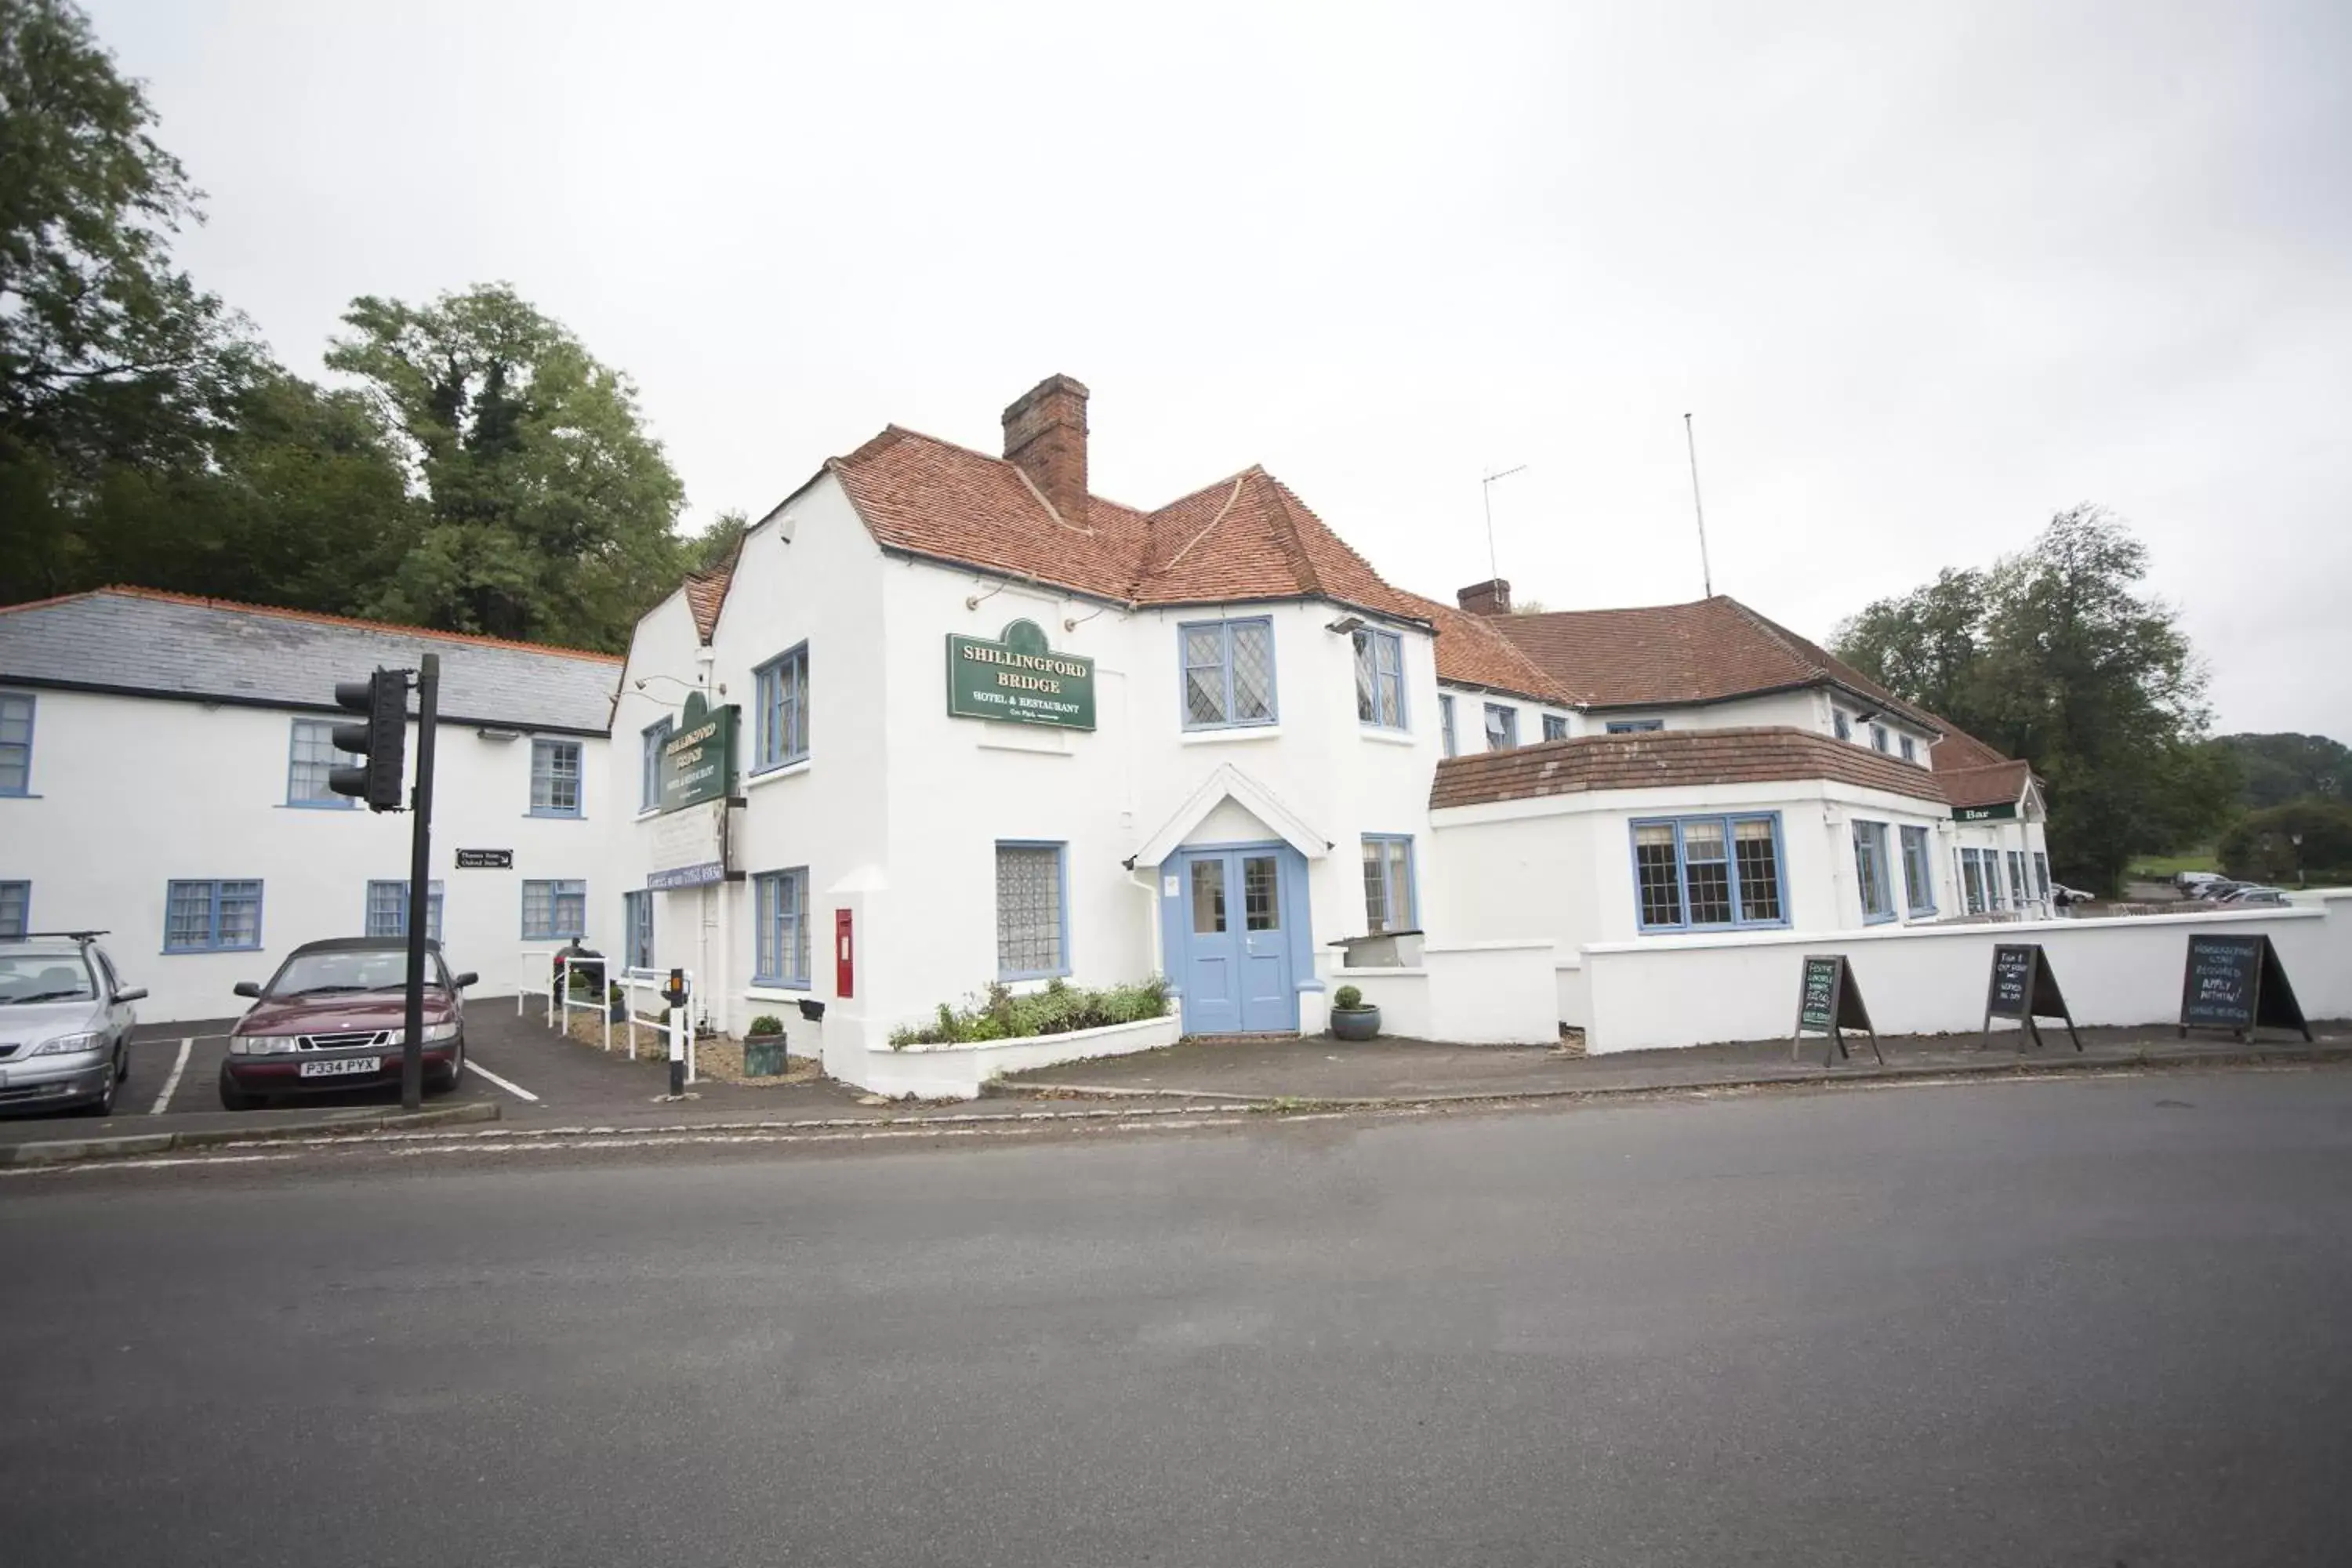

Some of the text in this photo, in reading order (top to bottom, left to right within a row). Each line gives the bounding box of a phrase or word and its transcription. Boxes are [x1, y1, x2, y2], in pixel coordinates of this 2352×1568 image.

[963, 645, 1087, 677] SHILLINGFORD
[997, 672, 1061, 694] BRIDGE
[973, 691, 1080, 714] HOTEL & RESTAURANT
[1965, 810, 1990, 819] Bar
[2202, 978, 2232, 991] APPLY
[307, 1058, 374, 1075] P334 PYX
